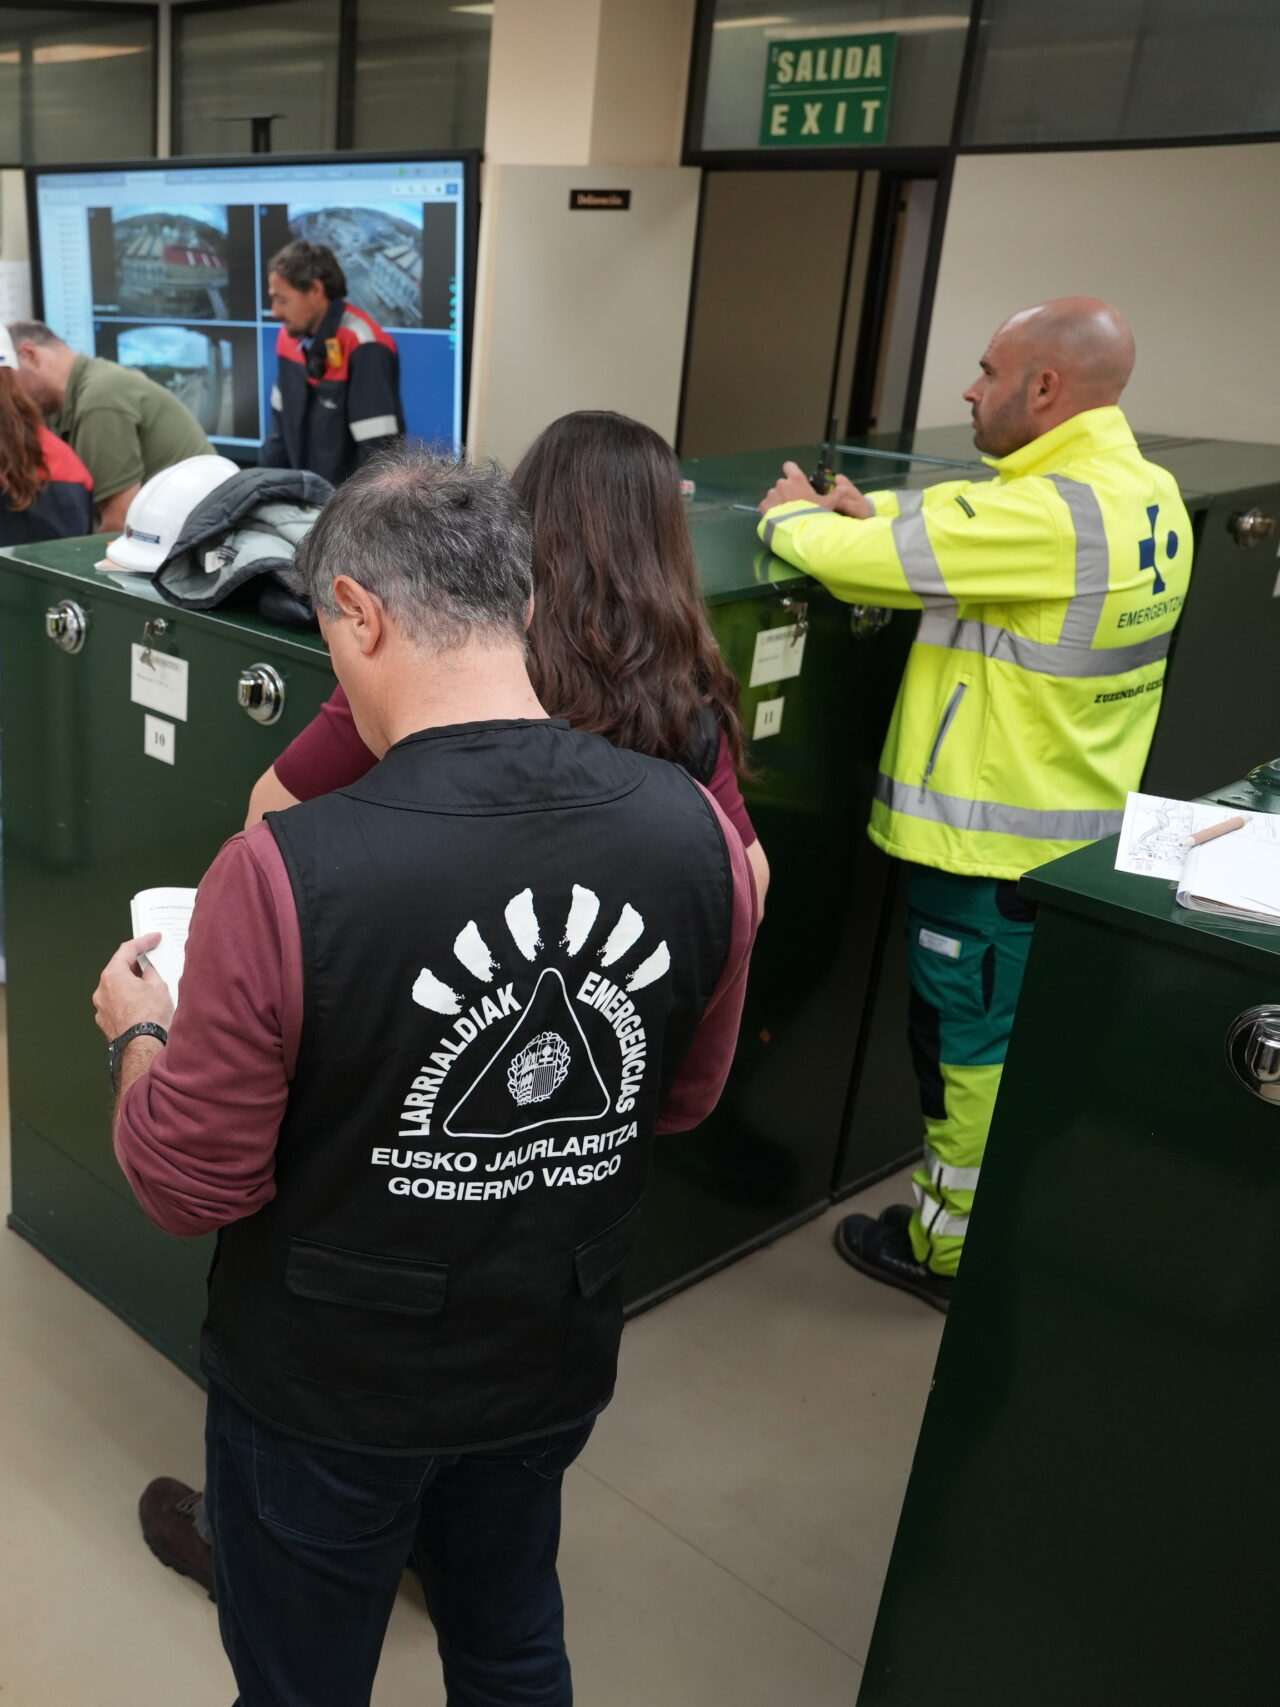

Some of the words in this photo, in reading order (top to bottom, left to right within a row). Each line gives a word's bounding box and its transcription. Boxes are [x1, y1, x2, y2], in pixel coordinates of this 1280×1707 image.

[777, 44, 882, 83] SALIDA
[770, 100, 881, 136] EXIT
[154, 731, 166, 747] 10
[399, 982, 522, 1136] LARRIALDIAK
[576, 971, 647, 1114] EMERGENCIAS
[371, 1147, 477, 1173] EUSKO
[485, 1121, 638, 1173] JAURLARITZA
[388, 1172, 534, 1201] GOBIERNO
[542, 1154, 622, 1188] VASCO
